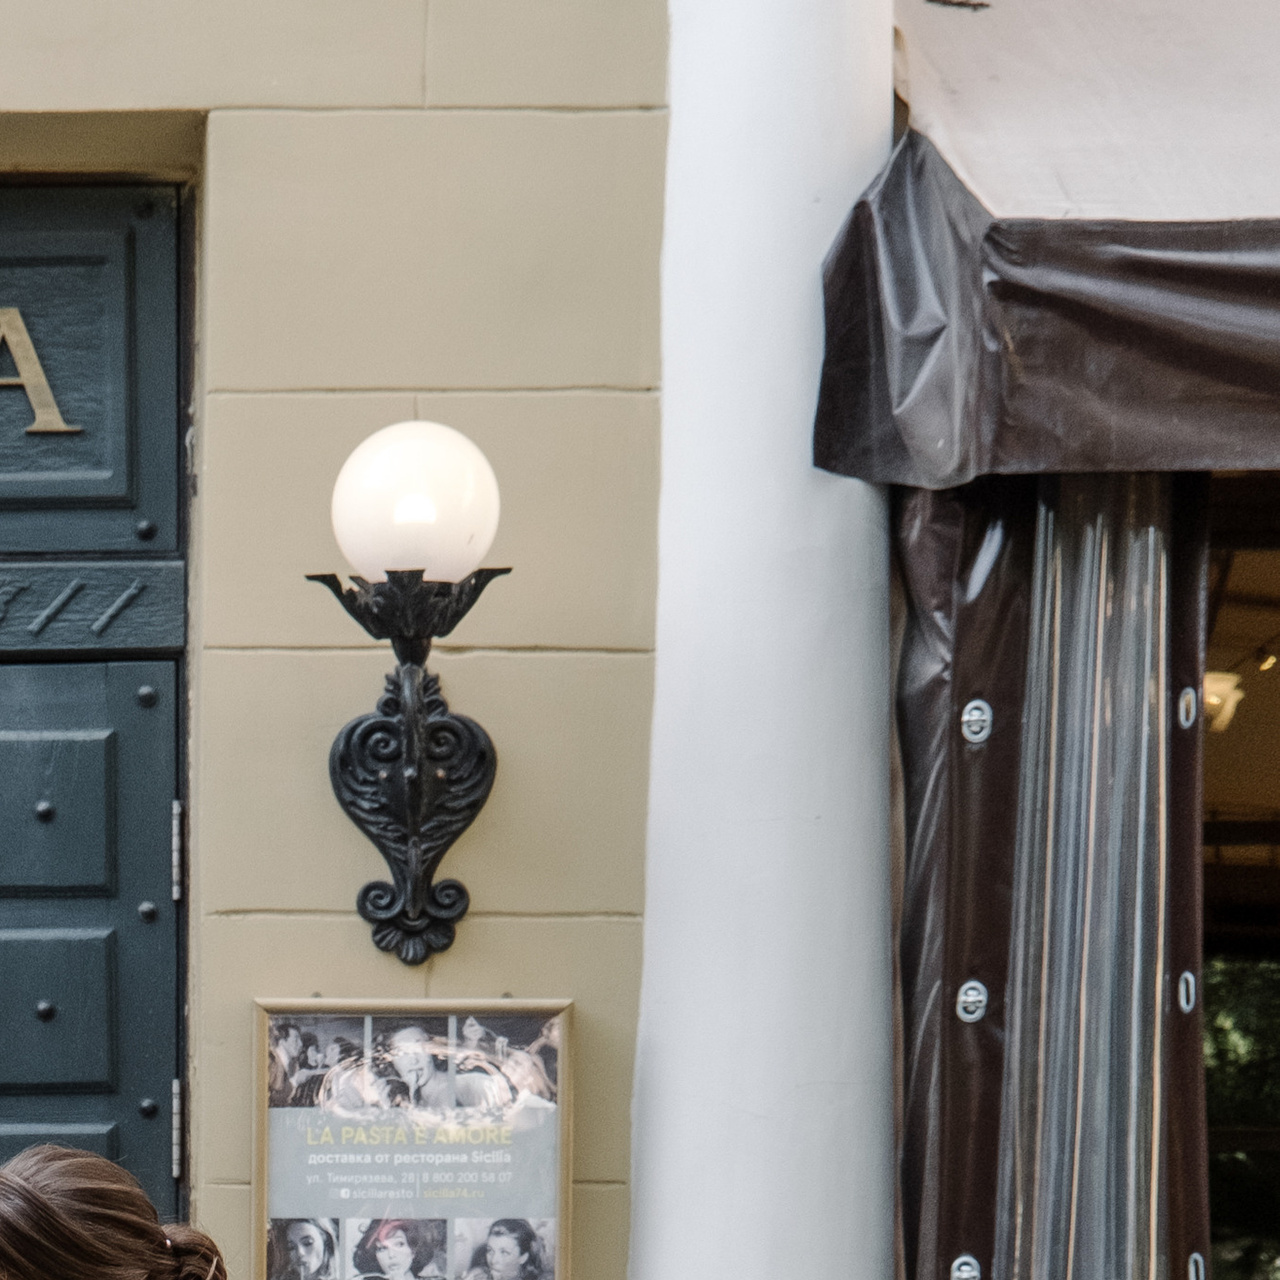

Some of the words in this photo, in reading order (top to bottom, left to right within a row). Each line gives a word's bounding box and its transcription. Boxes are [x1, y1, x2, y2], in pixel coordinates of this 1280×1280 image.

[306, 1126, 334, 1145] LA
[341, 1126, 408, 1145] PASTA
[433, 1126, 513, 1145] AMORE
[308, 1154, 371, 1164] доставка
[375, 1154, 390, 1163] от
[394, 1154, 468, 1166] ресторана
[472, 1150, 511, 1163] Sicilia
[433, 1172, 454, 1183] 800
[457, 1172, 478, 1183] 200
